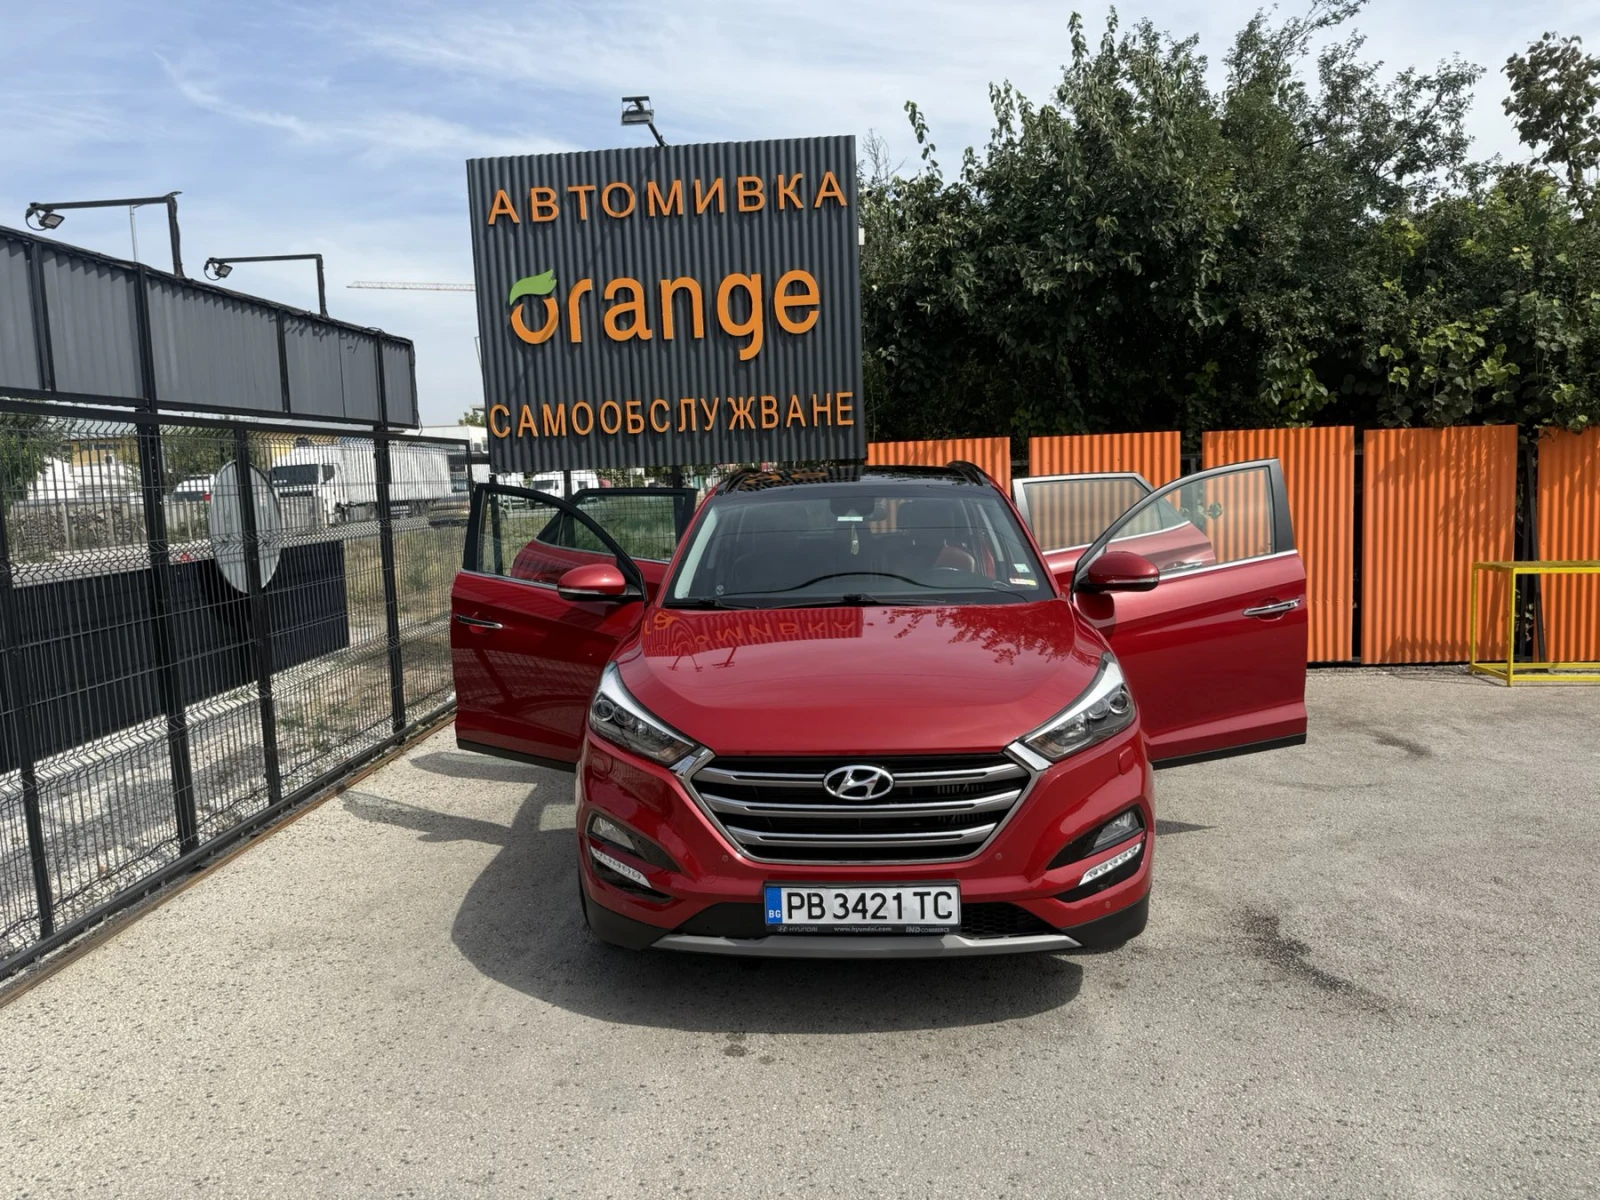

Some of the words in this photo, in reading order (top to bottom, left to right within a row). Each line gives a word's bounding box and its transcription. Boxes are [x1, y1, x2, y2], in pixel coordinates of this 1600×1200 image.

[487, 172, 848, 225] АВТОМИВКА
[510, 269, 821, 361] orange
[489, 392, 854, 438] САМООБСЛУЖВАНЕ
[768, 909, 782, 919] BG
[787, 892, 826, 920] PB
[833, 892, 903, 920] 3421
[913, 891, 953, 920] TC
